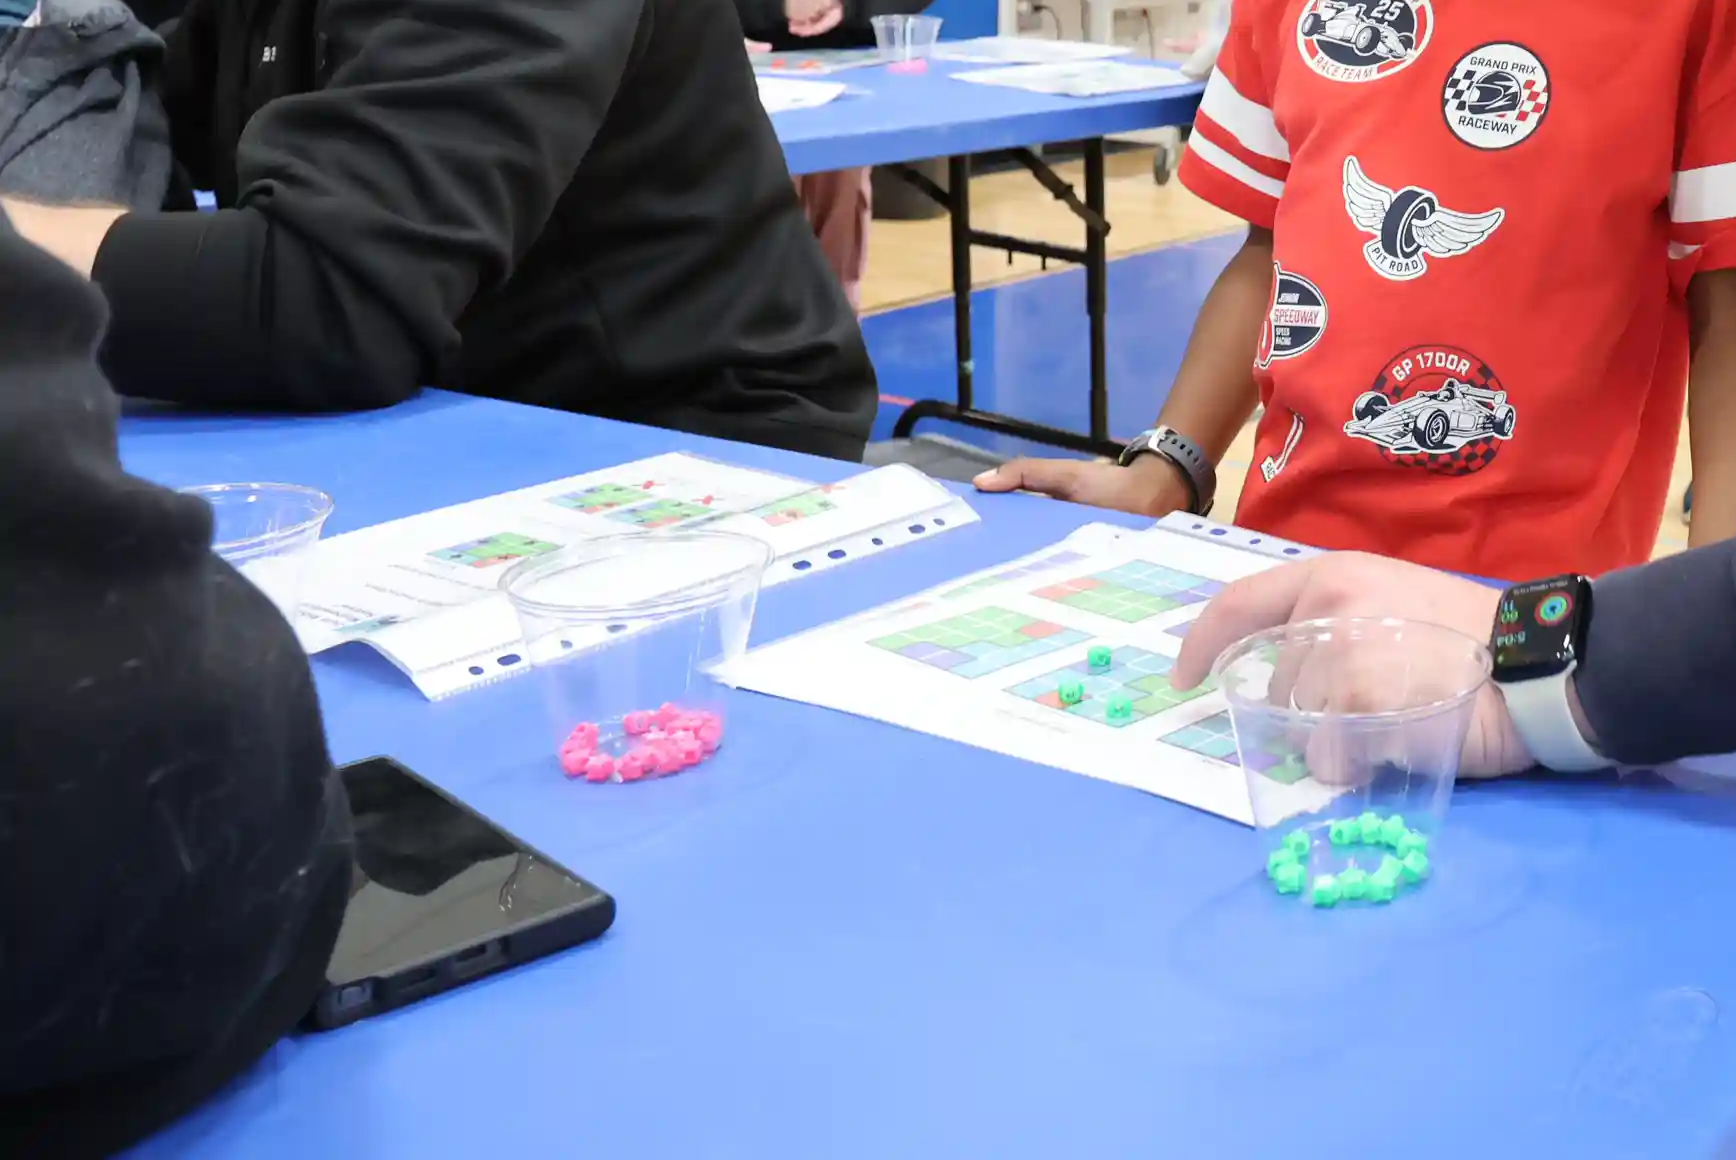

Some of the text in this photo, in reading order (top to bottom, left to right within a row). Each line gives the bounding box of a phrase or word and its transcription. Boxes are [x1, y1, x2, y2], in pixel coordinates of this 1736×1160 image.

[1315, 55, 1373, 80] RACE TEAM
[1469, 56, 1537, 75] GRAND PRIX
[1458, 115, 1518, 135] RACEWAY
[1371, 246, 1419, 272] PIT ROAD
[1274, 308, 1319, 325] SPEEDWAY
[1391, 351, 1470, 381] GP 1700R
